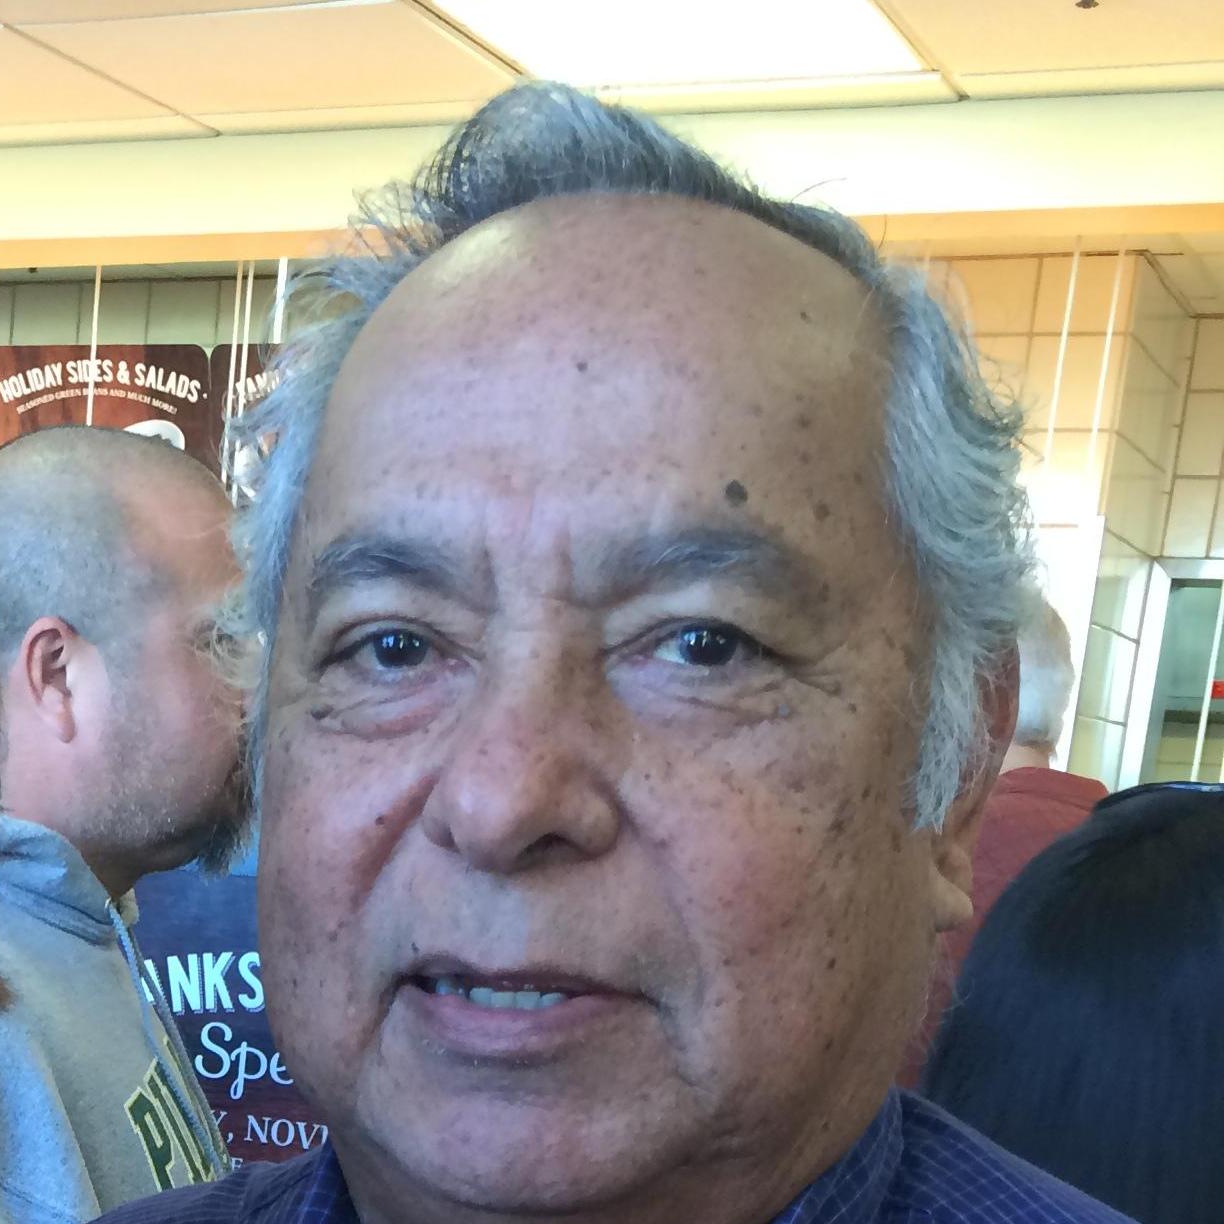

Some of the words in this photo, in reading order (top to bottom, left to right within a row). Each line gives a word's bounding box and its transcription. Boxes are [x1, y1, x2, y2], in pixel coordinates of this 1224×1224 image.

[66, 359, 114, 384] SIDES
[116, 360, 131, 387] &
[134, 362, 201, 403] SALADS
